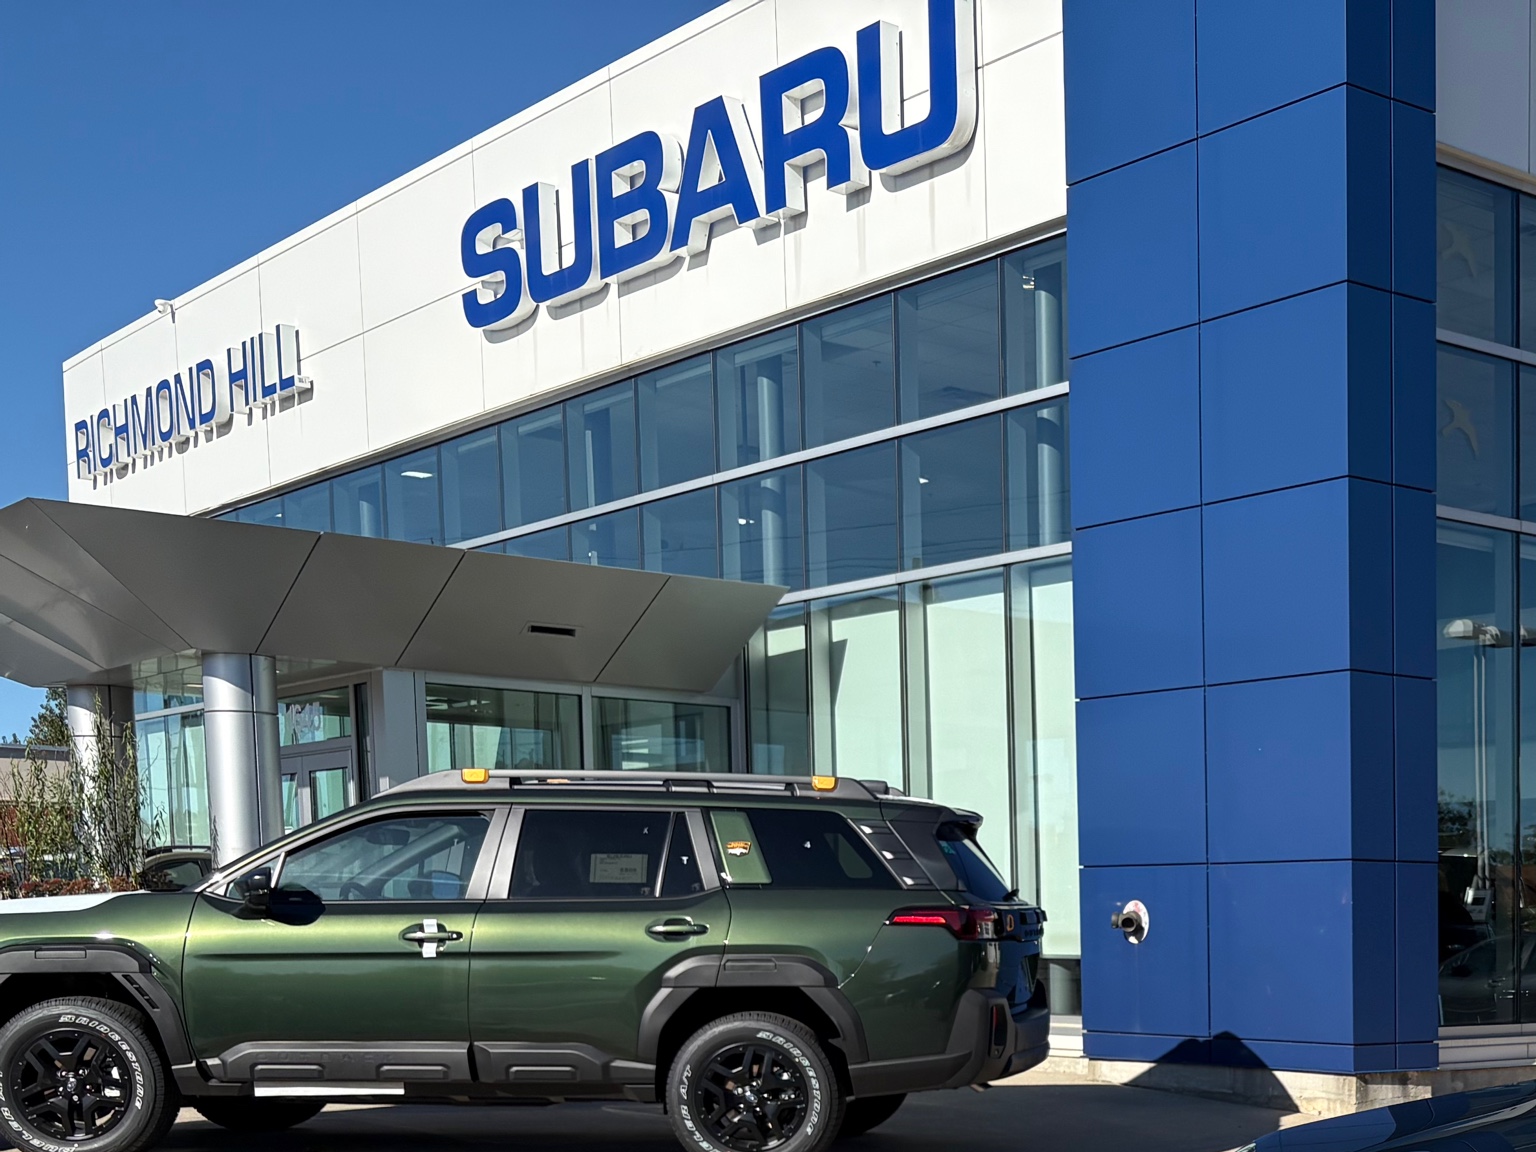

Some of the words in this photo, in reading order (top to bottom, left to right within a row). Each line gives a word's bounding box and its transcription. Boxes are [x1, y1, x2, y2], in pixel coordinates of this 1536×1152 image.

[461, 0, 958, 328] SUBARU
[74, 359, 217, 480] RICHMOND
[227, 323, 296, 413] HILL
